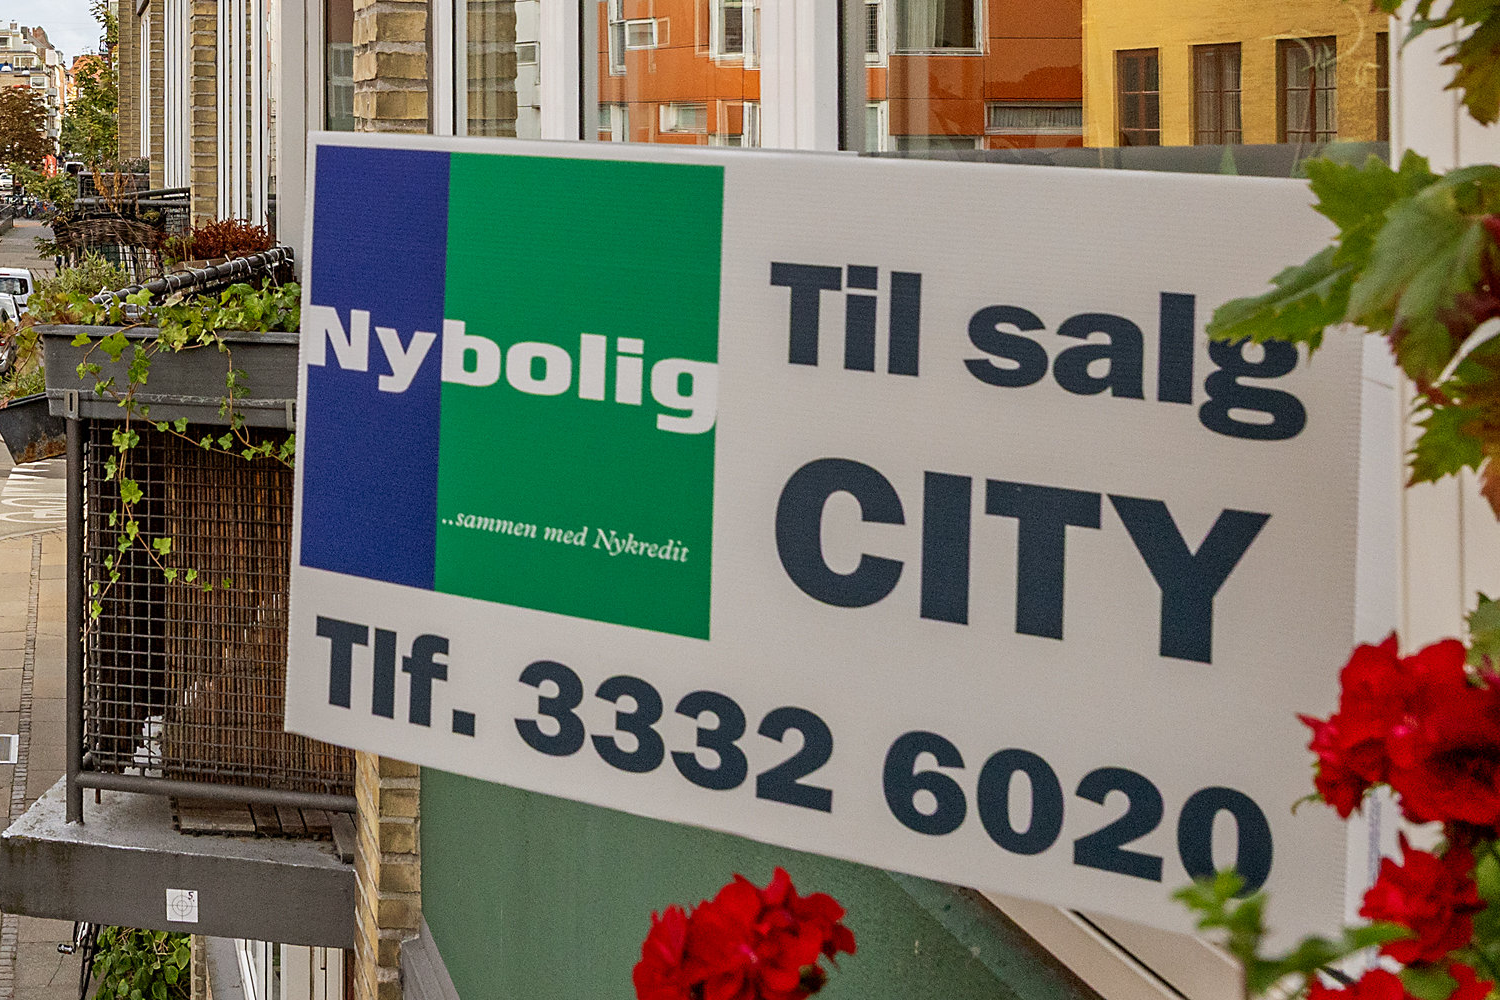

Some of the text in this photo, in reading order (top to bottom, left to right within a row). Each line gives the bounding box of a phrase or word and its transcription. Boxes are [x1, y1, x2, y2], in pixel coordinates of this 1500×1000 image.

[307, 304, 719, 435] Nybolig
[771, 262, 1307, 441] Til salg
[543, 526, 589, 547] med
[592, 528, 690, 563] Nykredit
[775, 457, 1273, 665] CITY
[315, 615, 1274, 899] Tlf. 3332 6020
